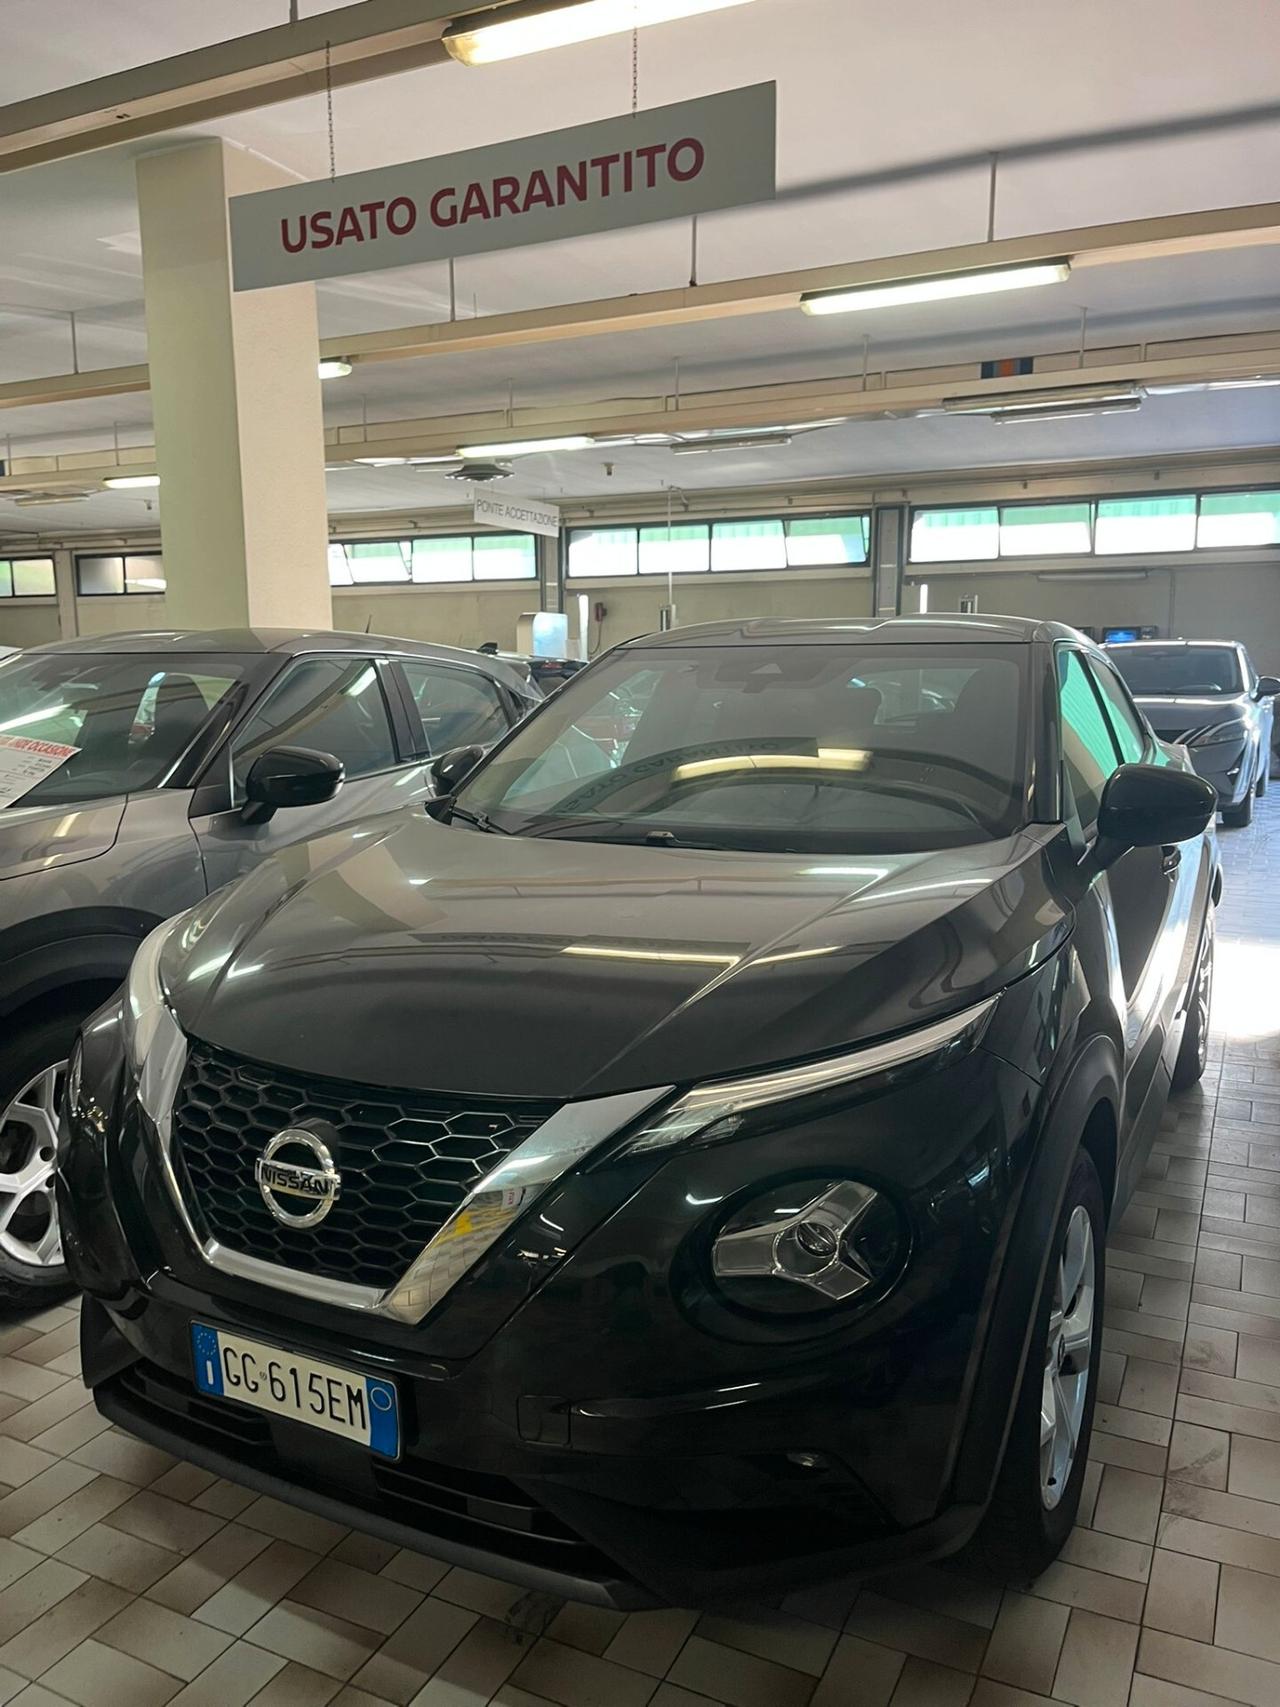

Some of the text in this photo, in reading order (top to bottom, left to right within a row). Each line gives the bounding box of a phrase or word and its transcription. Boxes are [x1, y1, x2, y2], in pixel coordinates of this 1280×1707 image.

[280, 137, 705, 253] USATO GARANTITO
[260, 1165, 329, 1195] NISSAN
